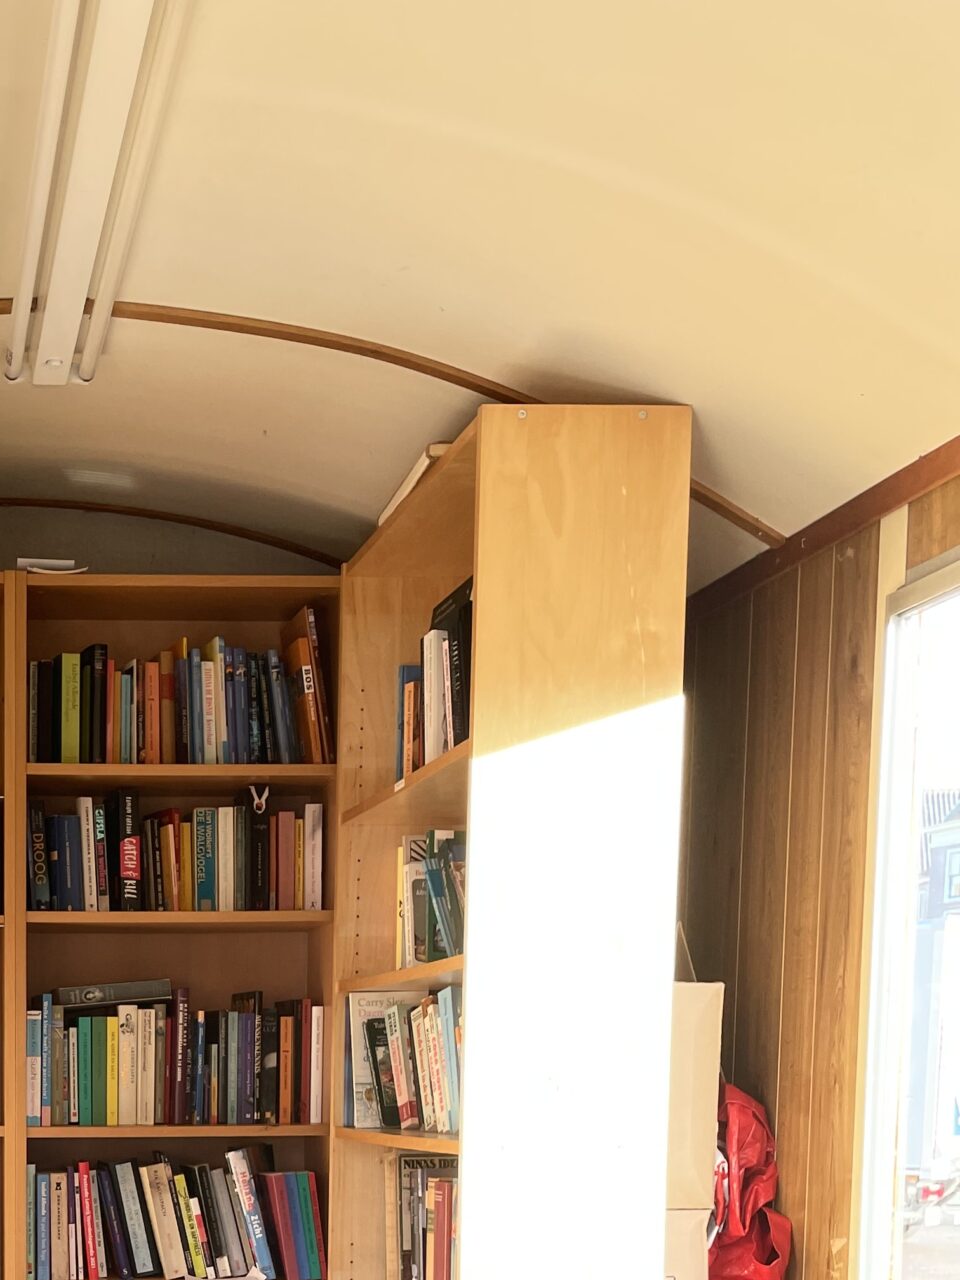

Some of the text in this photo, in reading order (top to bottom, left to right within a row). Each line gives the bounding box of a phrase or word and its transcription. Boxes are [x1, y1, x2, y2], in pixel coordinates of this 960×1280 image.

[304, 669, 312, 690] BOS
[33, 834, 45, 885] DROOG
[124, 838, 137, 868] CATCH
[197, 826, 206, 884] WALGVOGEL
[124, 880, 137, 899] KILL
[357, 998, 383, 1008] Carry
[240, 1171, 263, 1238] Holland Zicht
